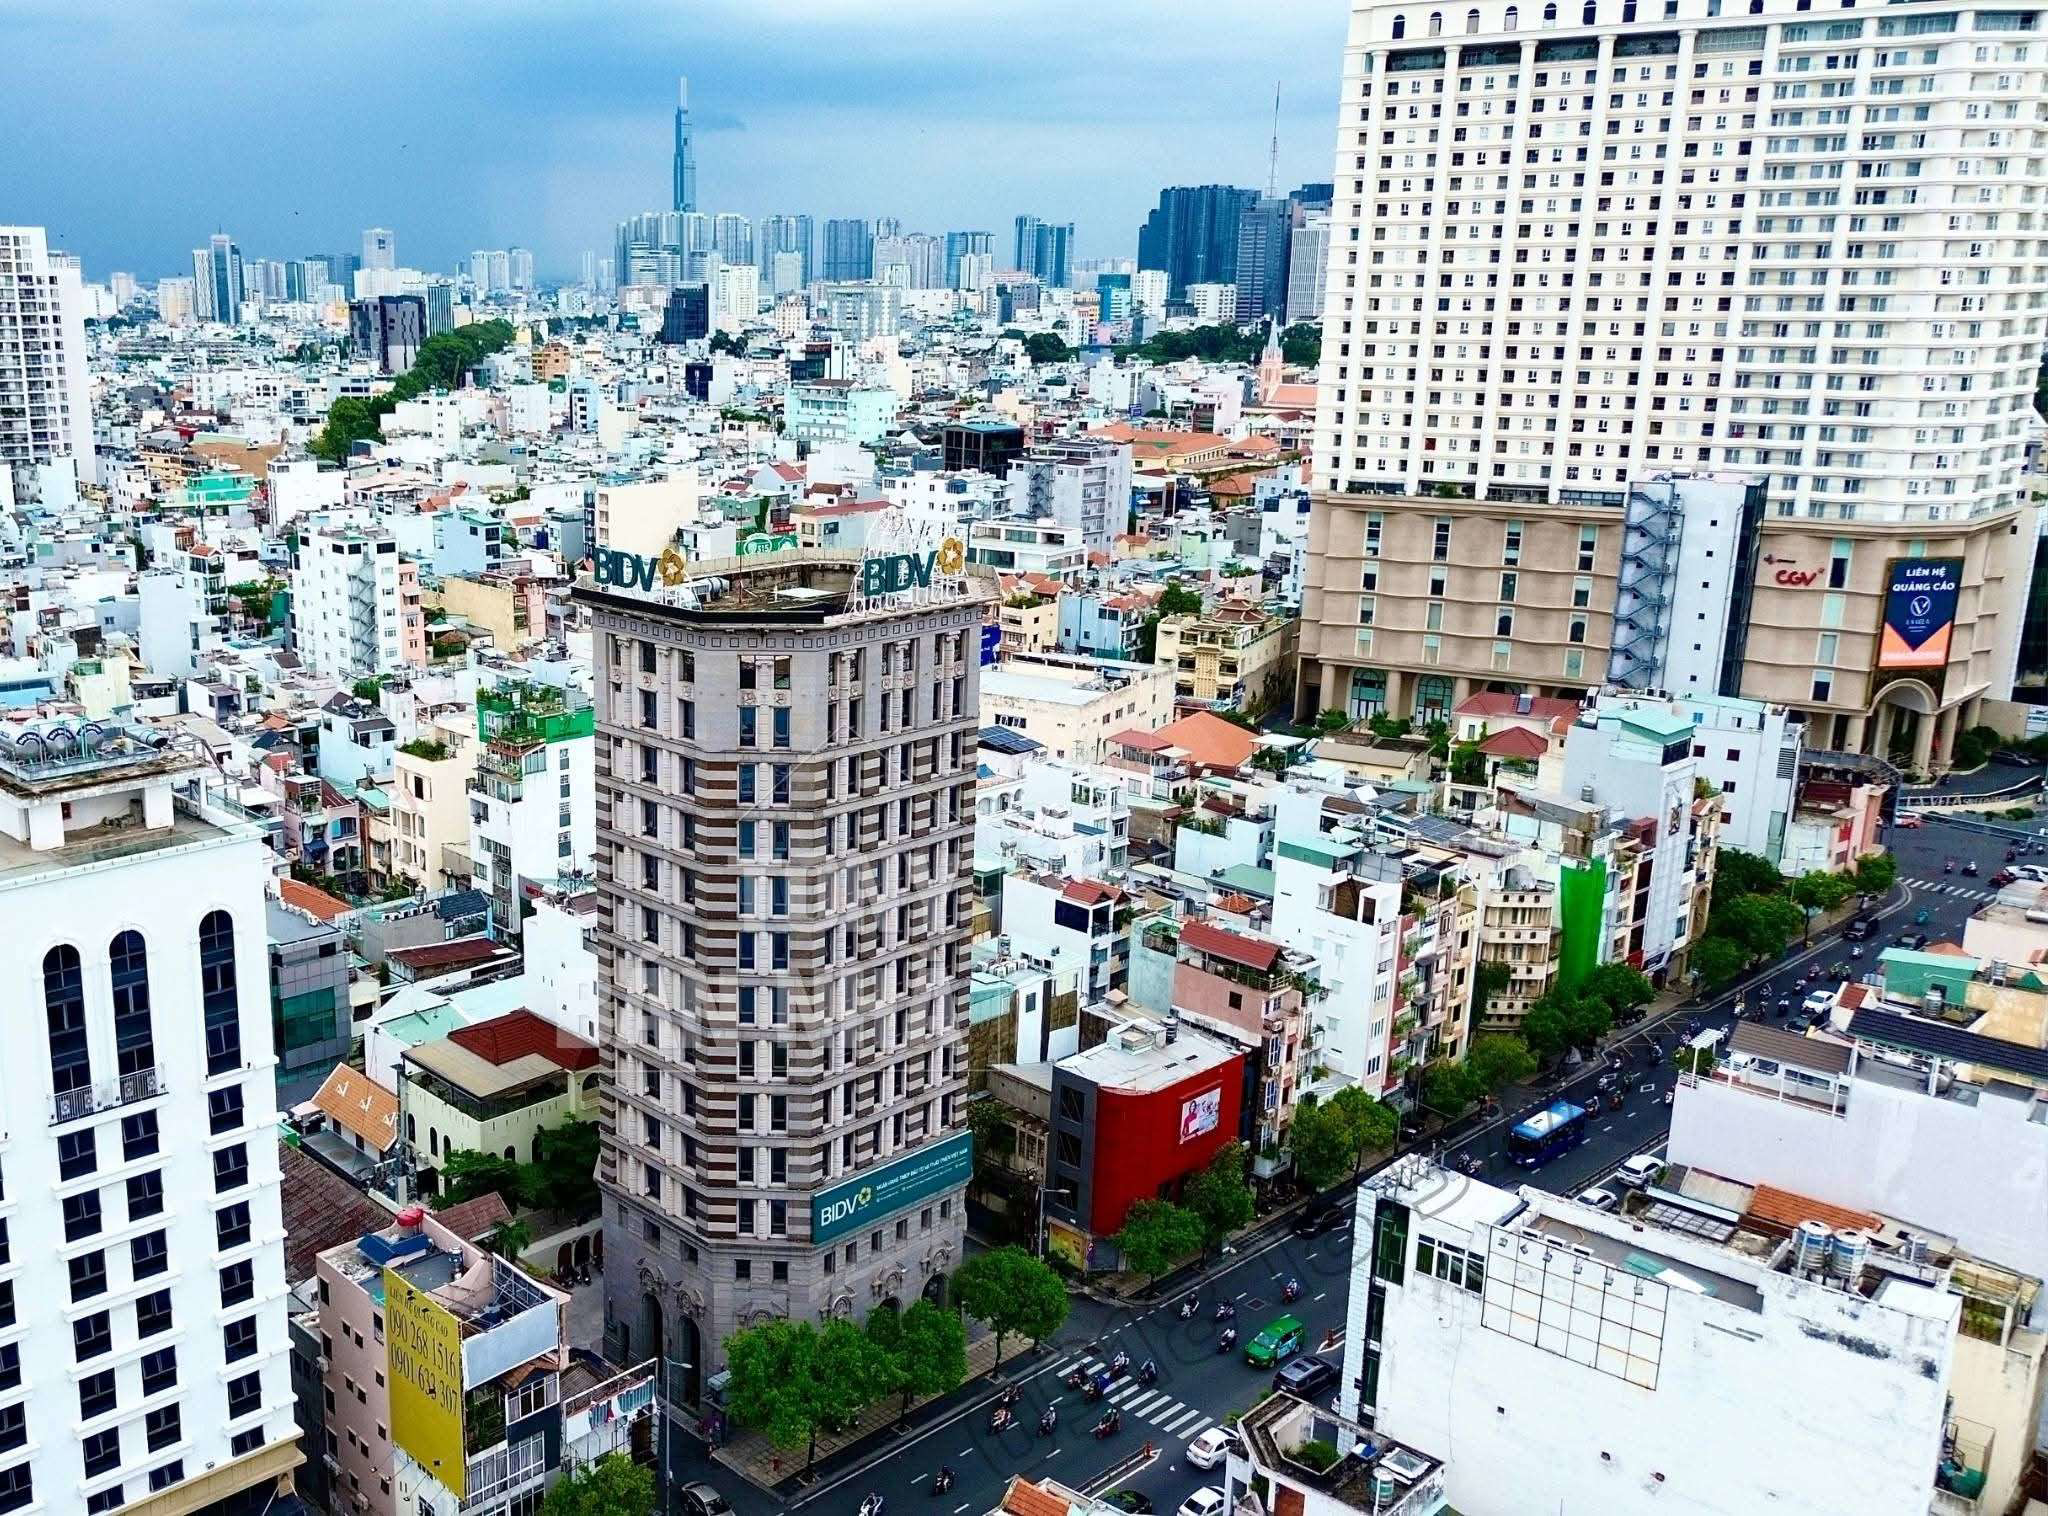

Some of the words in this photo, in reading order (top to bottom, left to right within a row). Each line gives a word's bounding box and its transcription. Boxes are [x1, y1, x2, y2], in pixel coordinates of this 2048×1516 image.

[592, 547, 658, 592] BIDV
[864, 550, 938, 597] BIDV
[1776, 569, 1817, 586] CGV
[820, 1194, 859, 1227] BIDV
[390, 1305, 408, 1343] 090
[411, 1321, 429, 1360] 268
[432, 1338, 457, 1380] 1516
[391, 1342, 415, 1384] 0901
[440, 1380, 458, 1417] 307
